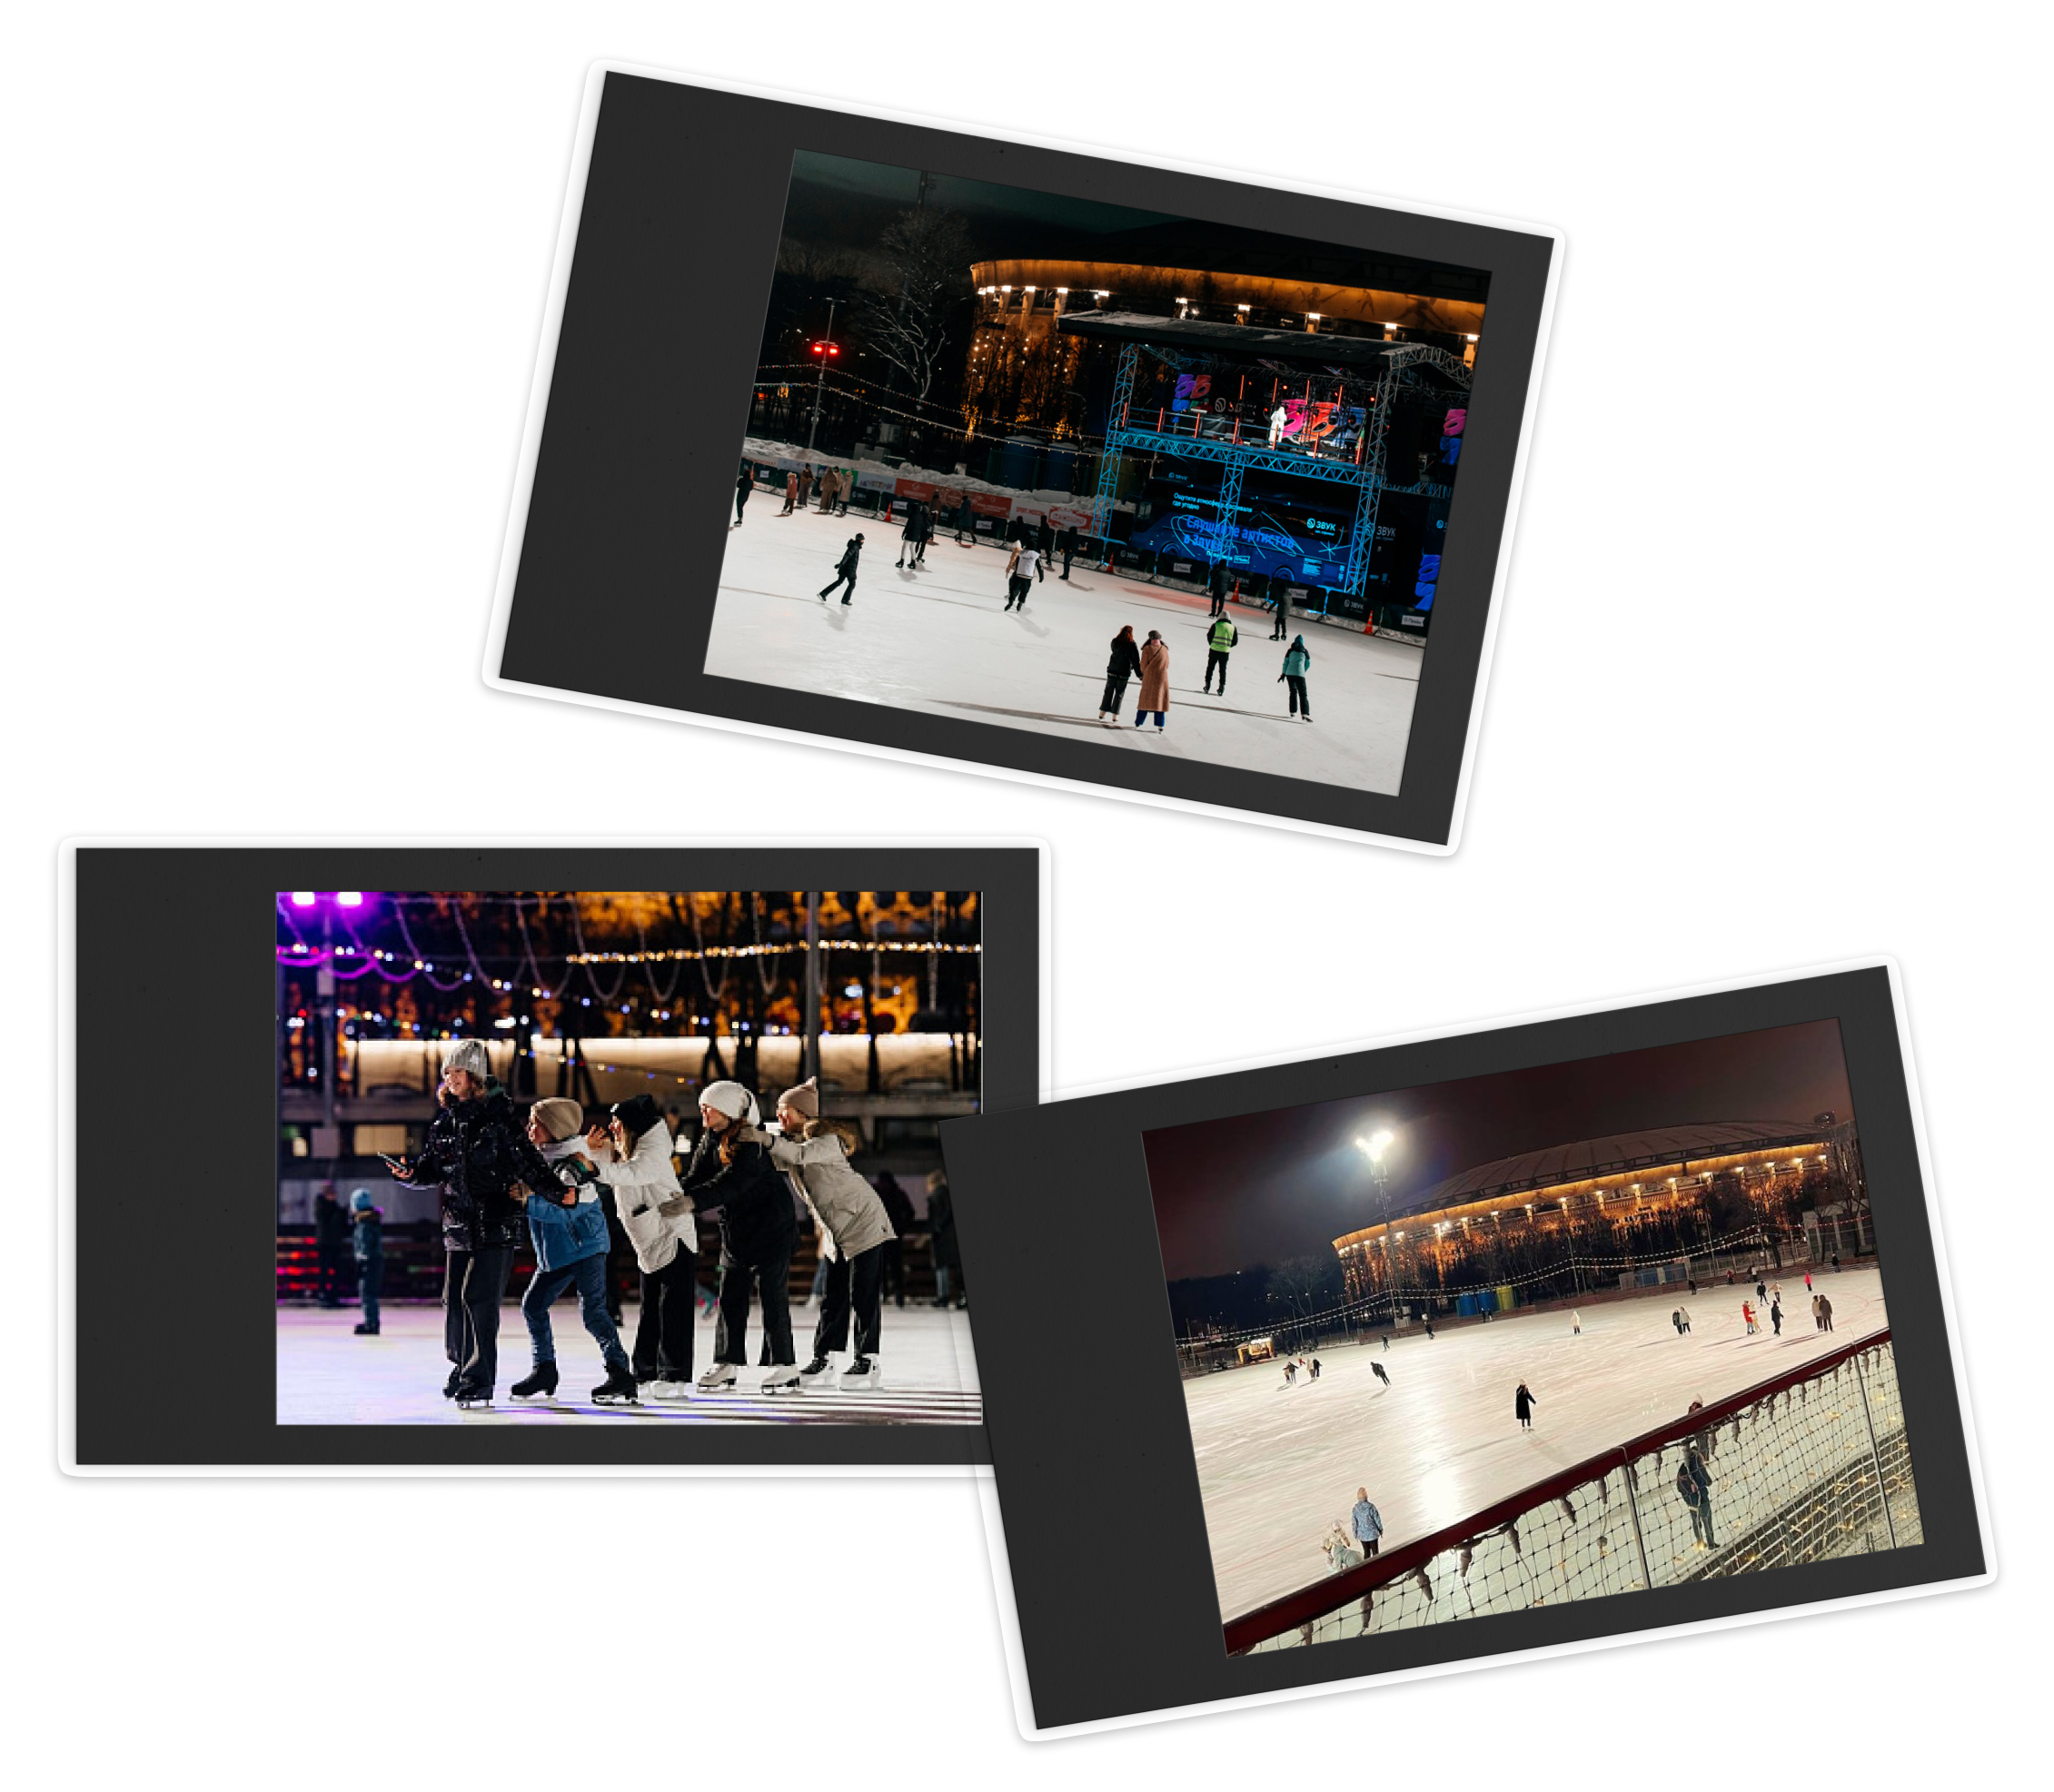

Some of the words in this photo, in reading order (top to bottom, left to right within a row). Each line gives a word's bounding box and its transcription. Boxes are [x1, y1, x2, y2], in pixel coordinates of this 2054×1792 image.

[1315, 520, 1336, 531] ЗВУК
[1376, 525, 1396, 537] ЗВУК
[1242, 529, 1295, 549] артистов
